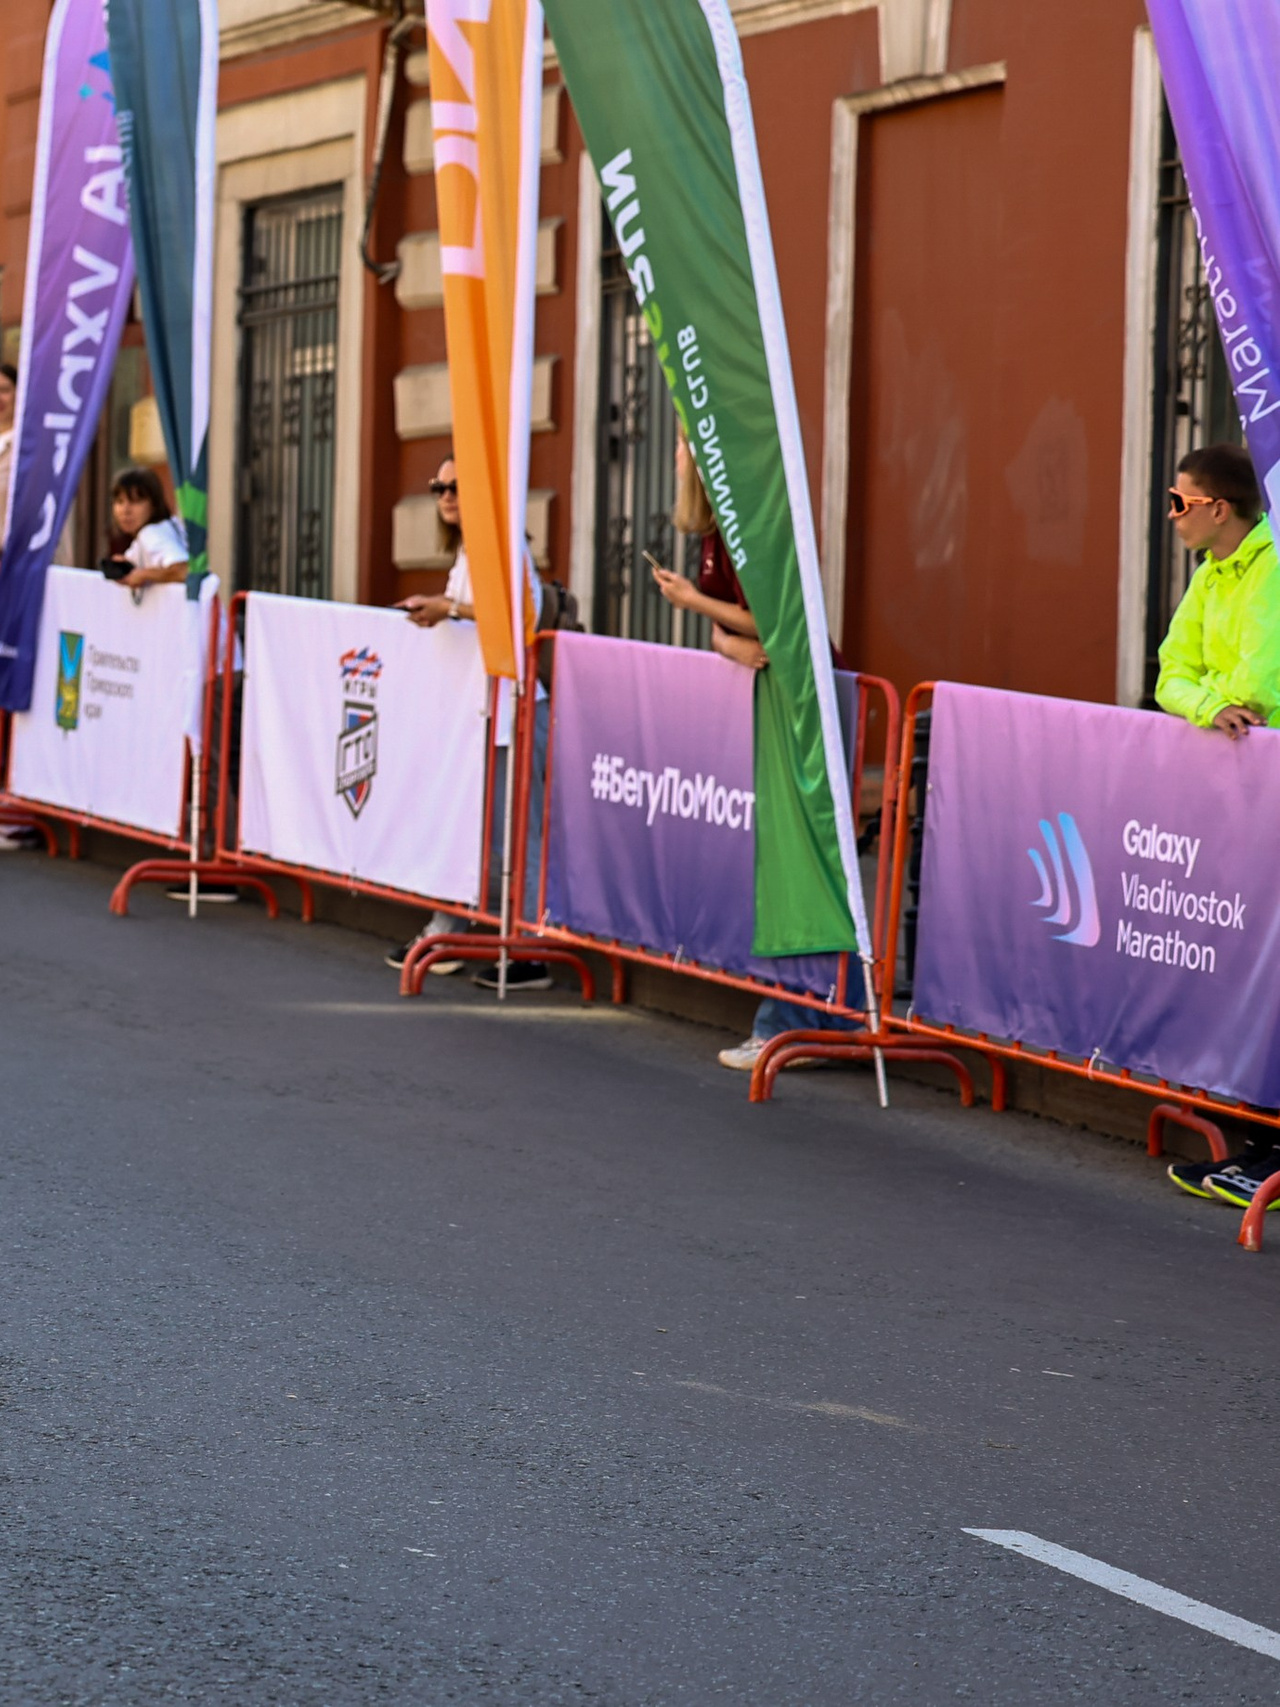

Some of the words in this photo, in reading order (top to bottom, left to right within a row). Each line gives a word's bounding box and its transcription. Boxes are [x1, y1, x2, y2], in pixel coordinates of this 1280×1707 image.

[80, 144, 128, 226] AI
[1122, 819, 1201, 878] Galaxy
[1121, 871, 1247, 930] Vladivostok
[1116, 918, 1216, 973] Marathon
